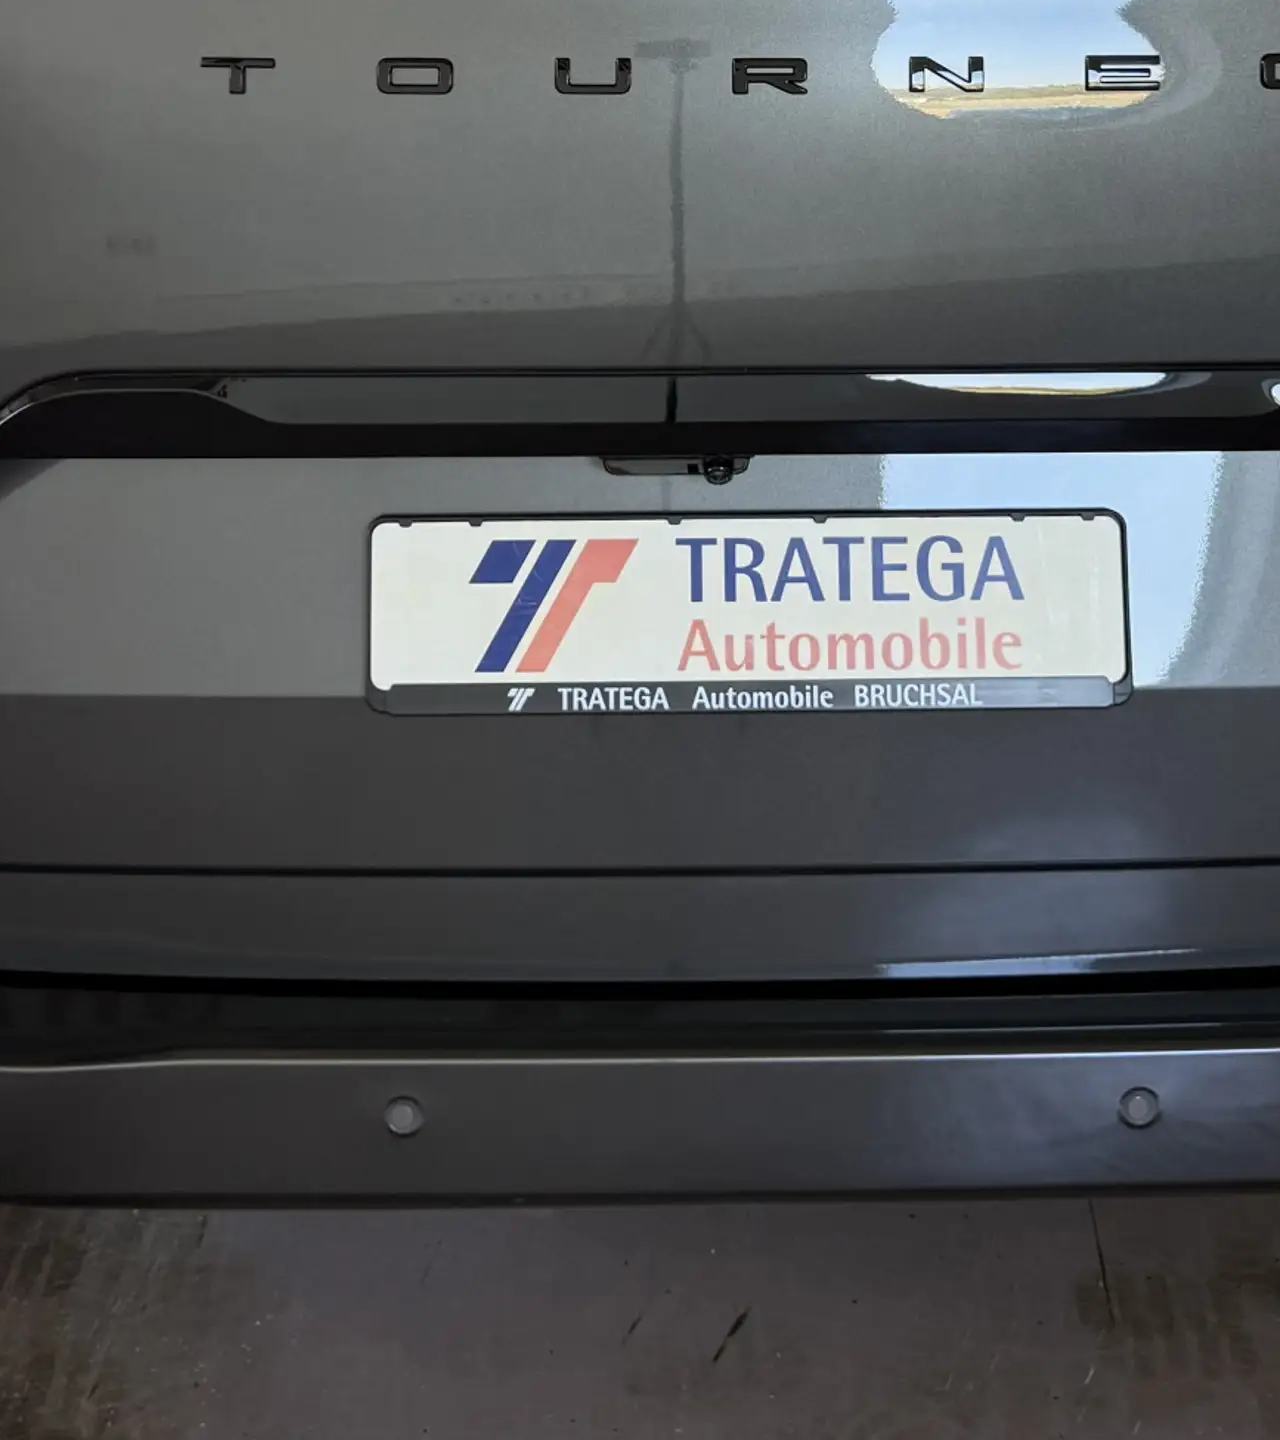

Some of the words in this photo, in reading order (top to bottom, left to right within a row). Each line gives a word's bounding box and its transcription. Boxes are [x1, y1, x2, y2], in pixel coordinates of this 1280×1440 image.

[675, 534, 1024, 603] TRATEGA
[677, 616, 1023, 672] Automobile
[557, 686, 670, 712] TRATEGA
[692, 684, 834, 710] Automobile
[854, 682, 984, 709] BRUCHSAL
